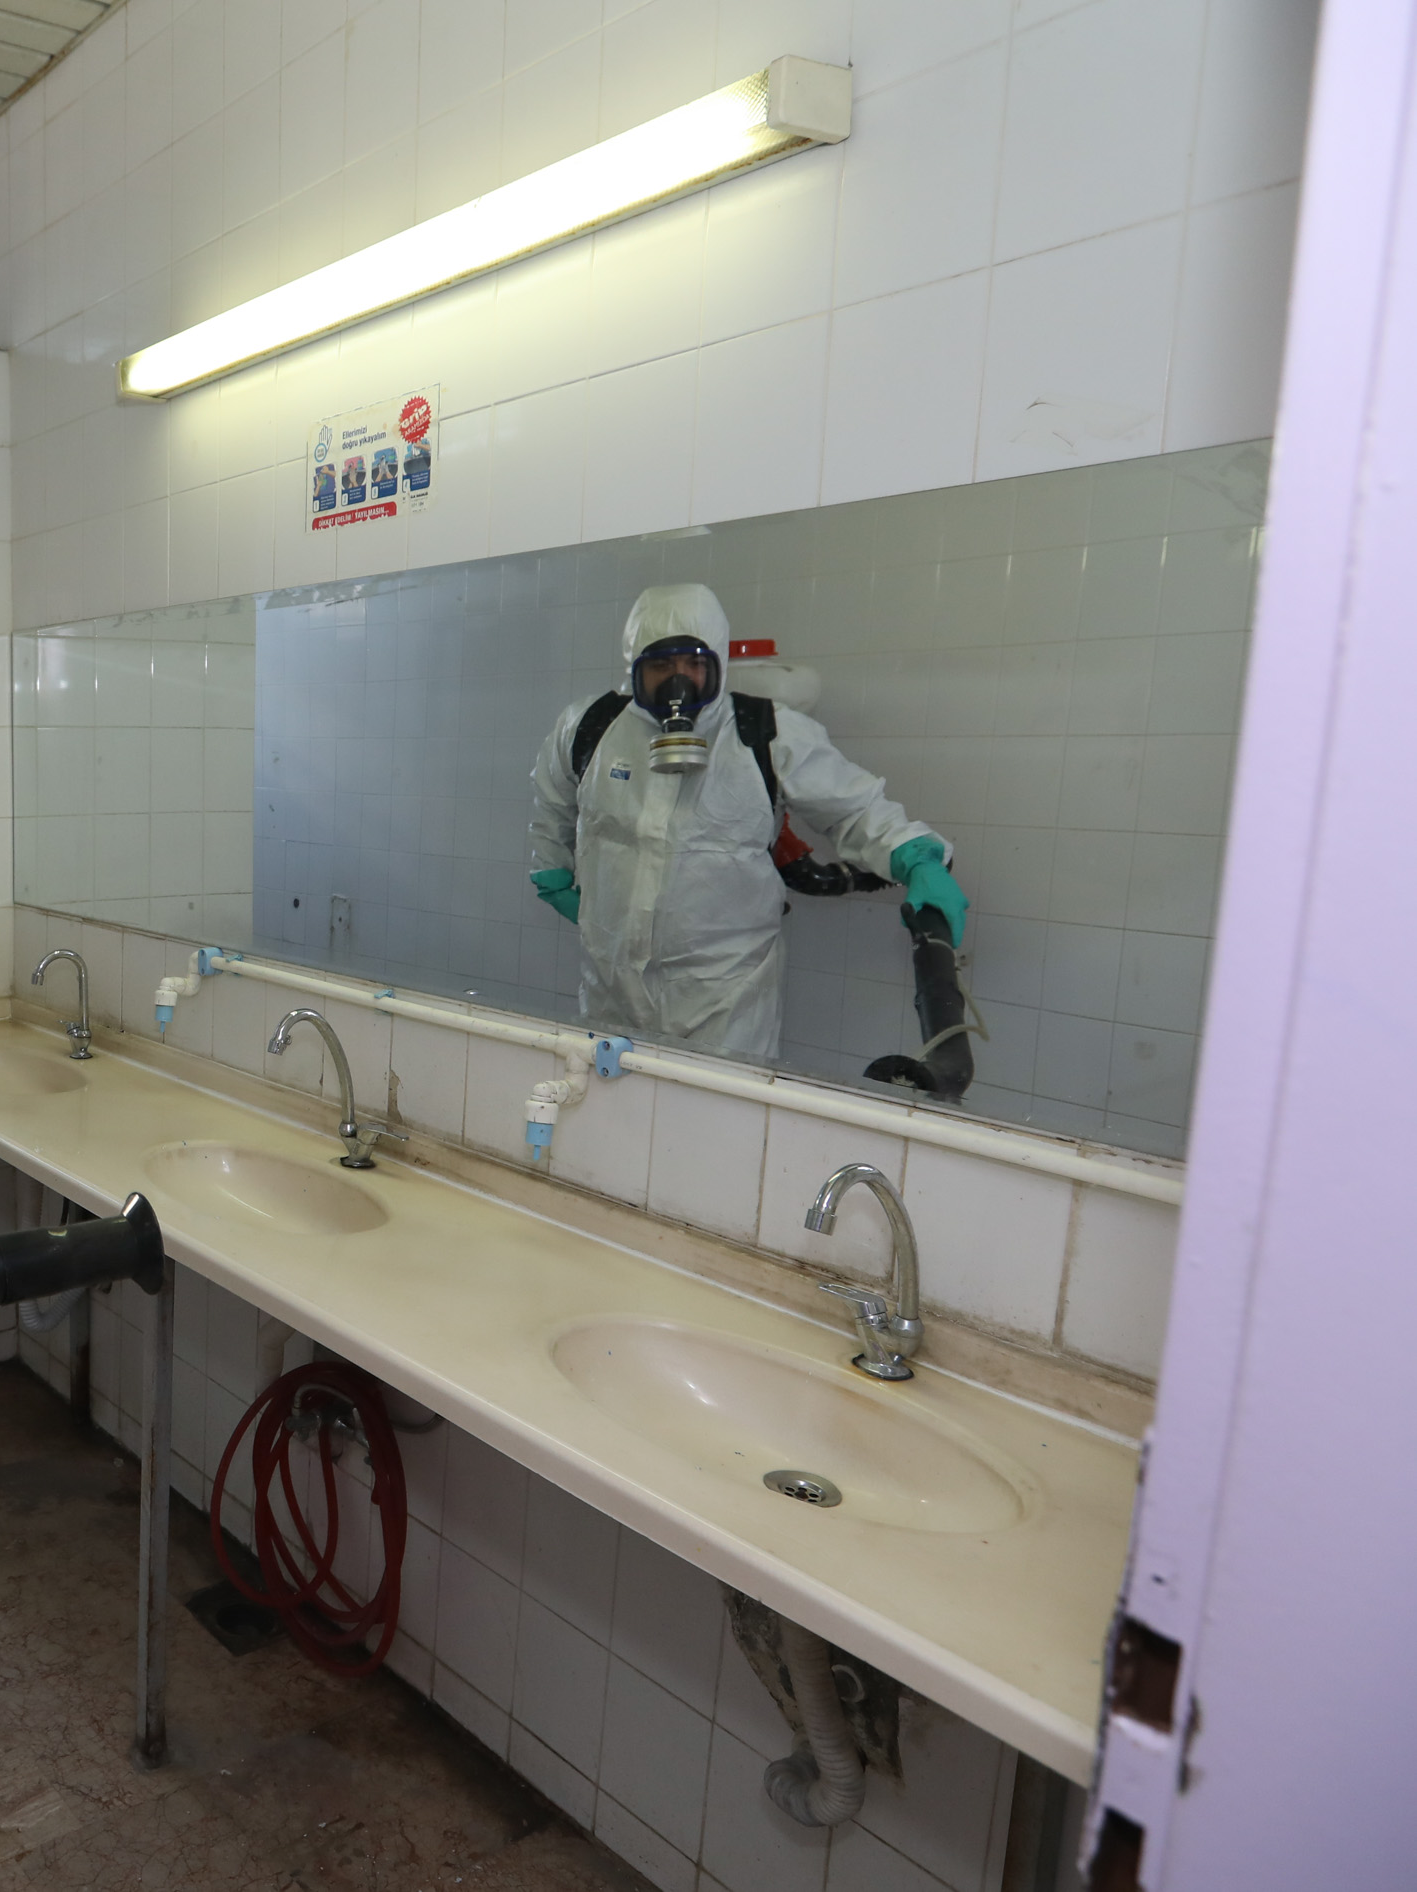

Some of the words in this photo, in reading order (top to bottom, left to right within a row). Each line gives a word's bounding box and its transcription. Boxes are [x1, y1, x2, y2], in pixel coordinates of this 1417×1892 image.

[342, 426, 368, 439] Ellerimizi
[342, 440, 359, 450] doğru
[359, 432, 386, 446] yıkayalım
